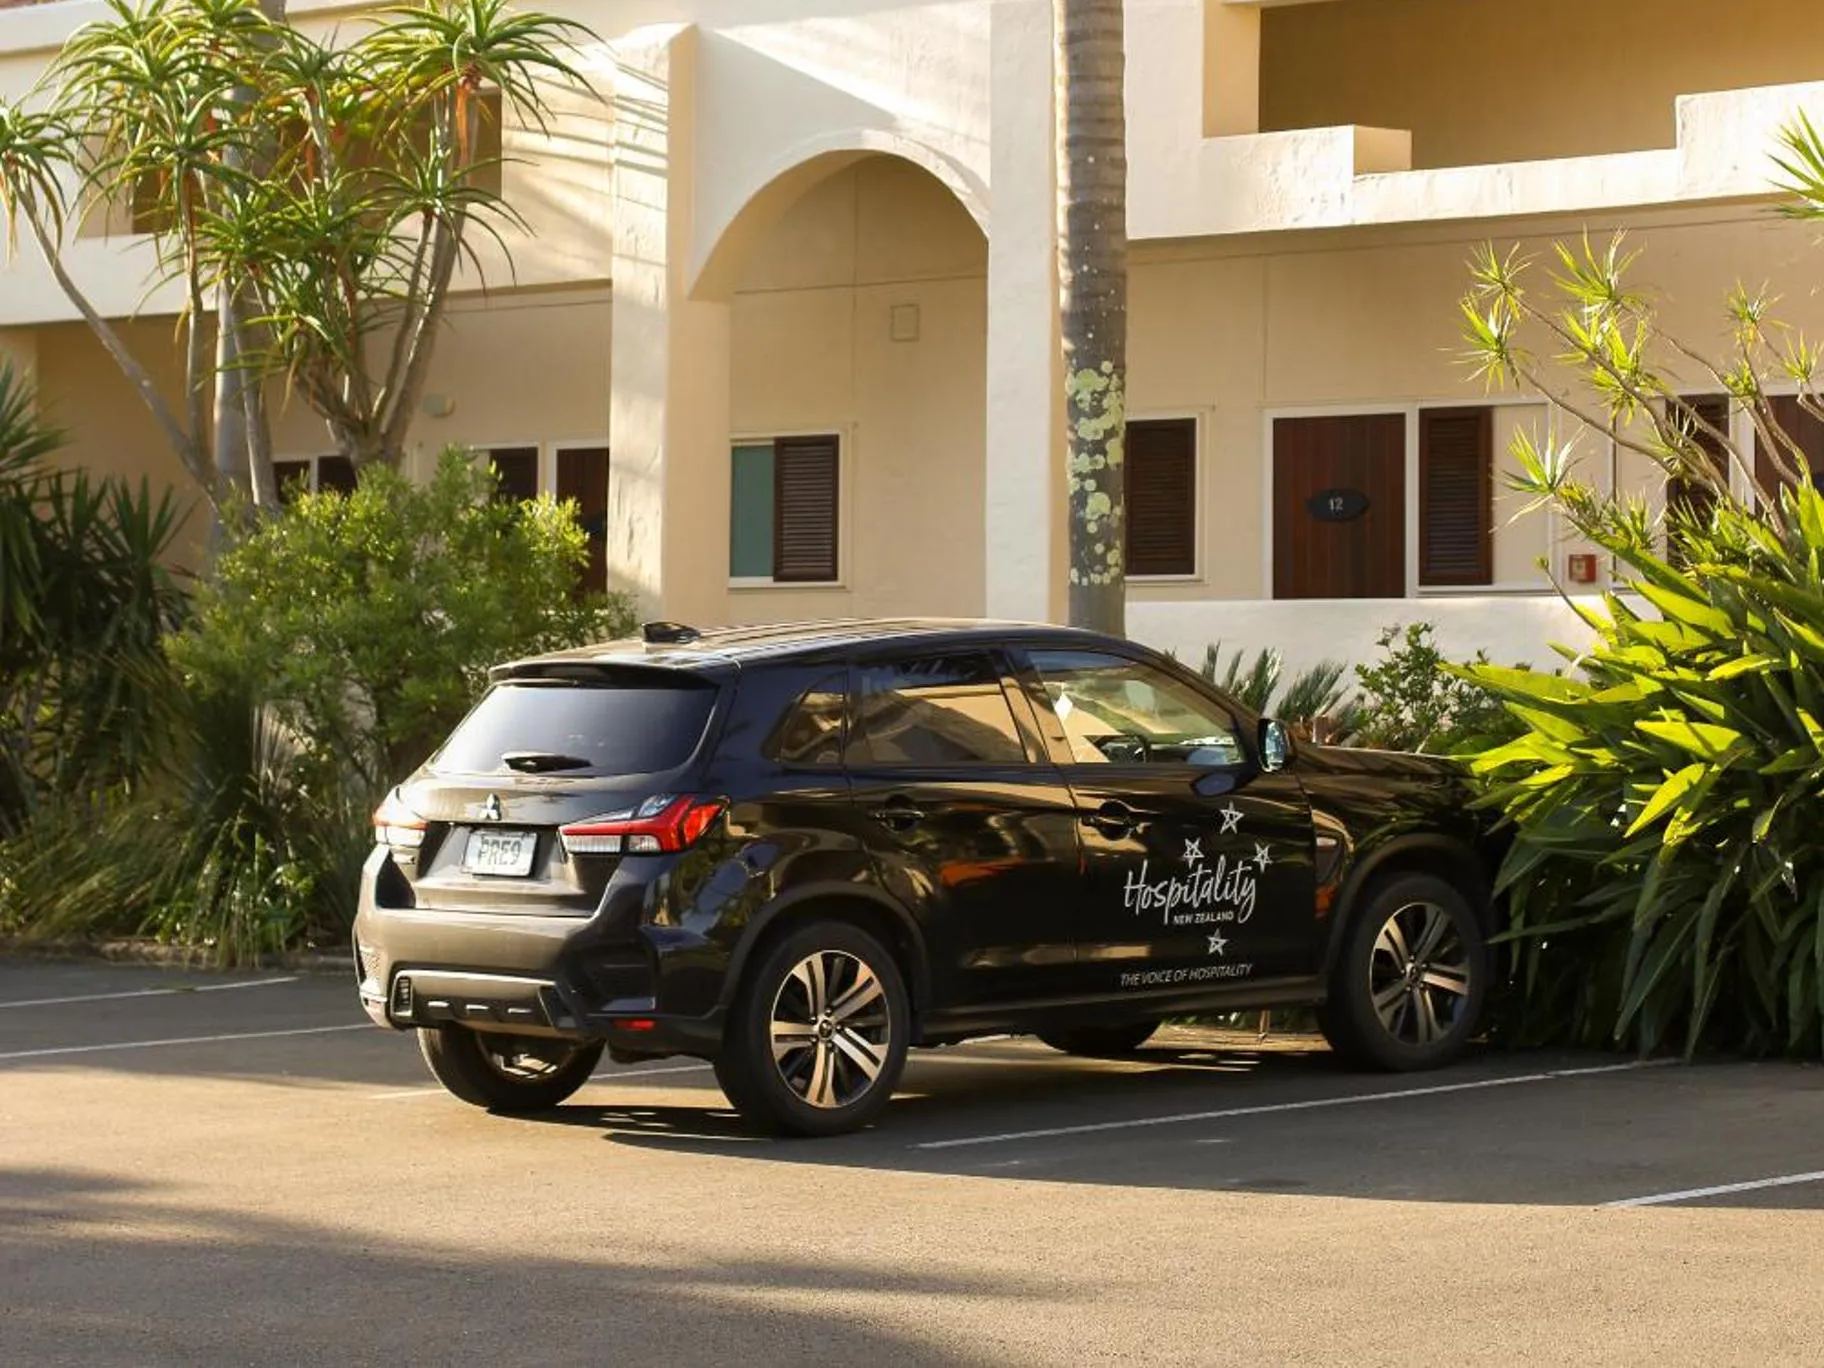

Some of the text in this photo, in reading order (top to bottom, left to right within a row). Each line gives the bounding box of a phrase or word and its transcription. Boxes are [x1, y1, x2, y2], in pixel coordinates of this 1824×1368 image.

[1328, 496, 1344, 511] 12
[1123, 854, 1256, 925] Hospitality
[1173, 911, 1234, 925] NEW ZEALAND
[1121, 964, 1252, 987] THE VOICE OF HOSPITALITY
